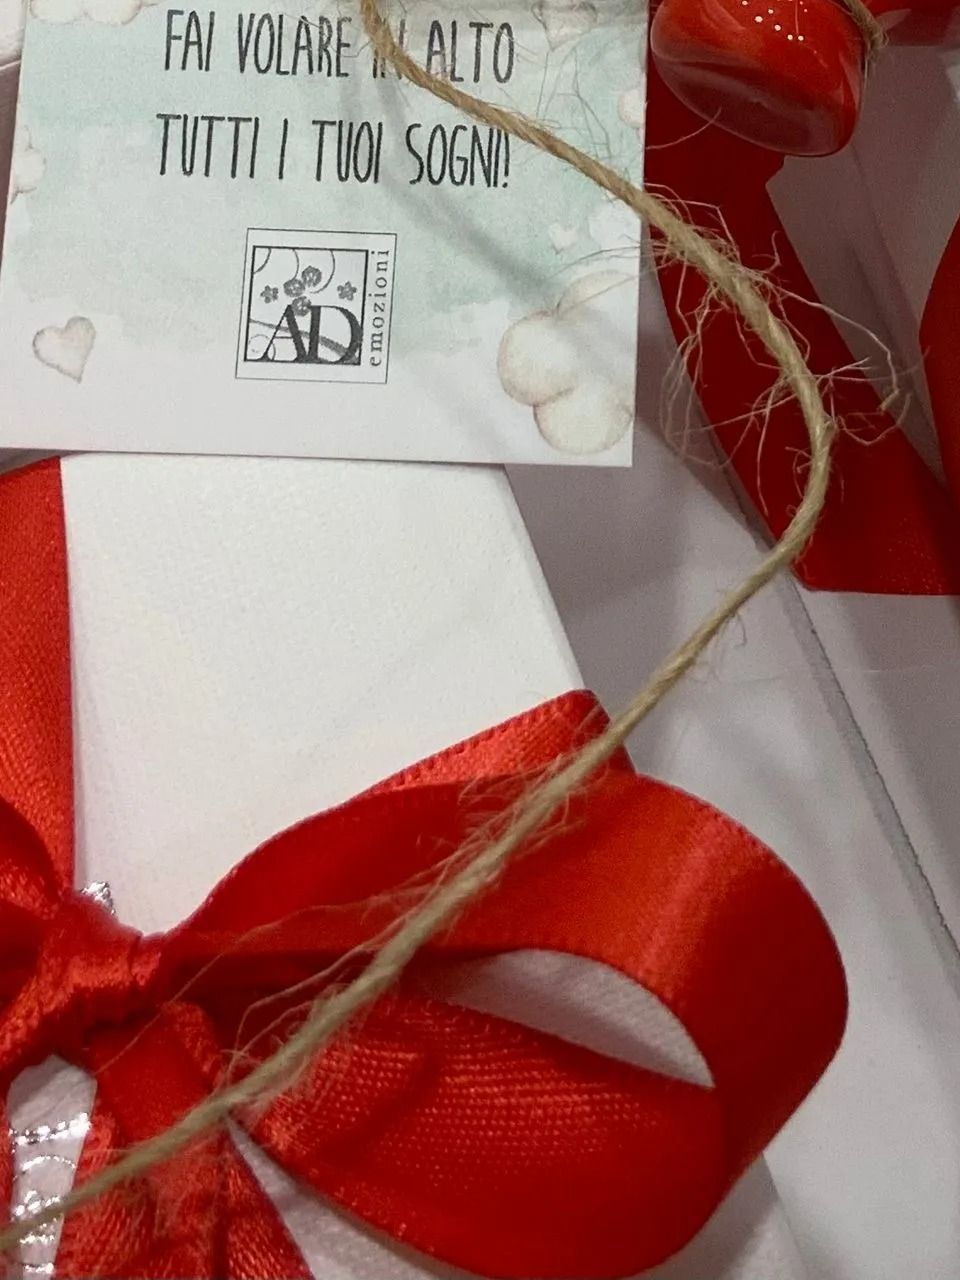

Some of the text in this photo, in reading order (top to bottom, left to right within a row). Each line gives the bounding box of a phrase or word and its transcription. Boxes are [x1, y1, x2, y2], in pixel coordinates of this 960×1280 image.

[164, 9, 215, 71] FAI
[238, 13, 352, 78] VOLARE
[426, 20, 515, 84] ALTO
[156, 114, 511, 188] TUTTI I TUOI SOGNI!
[256, 304, 364, 365] AD
[368, 250, 390, 368] emozioni
